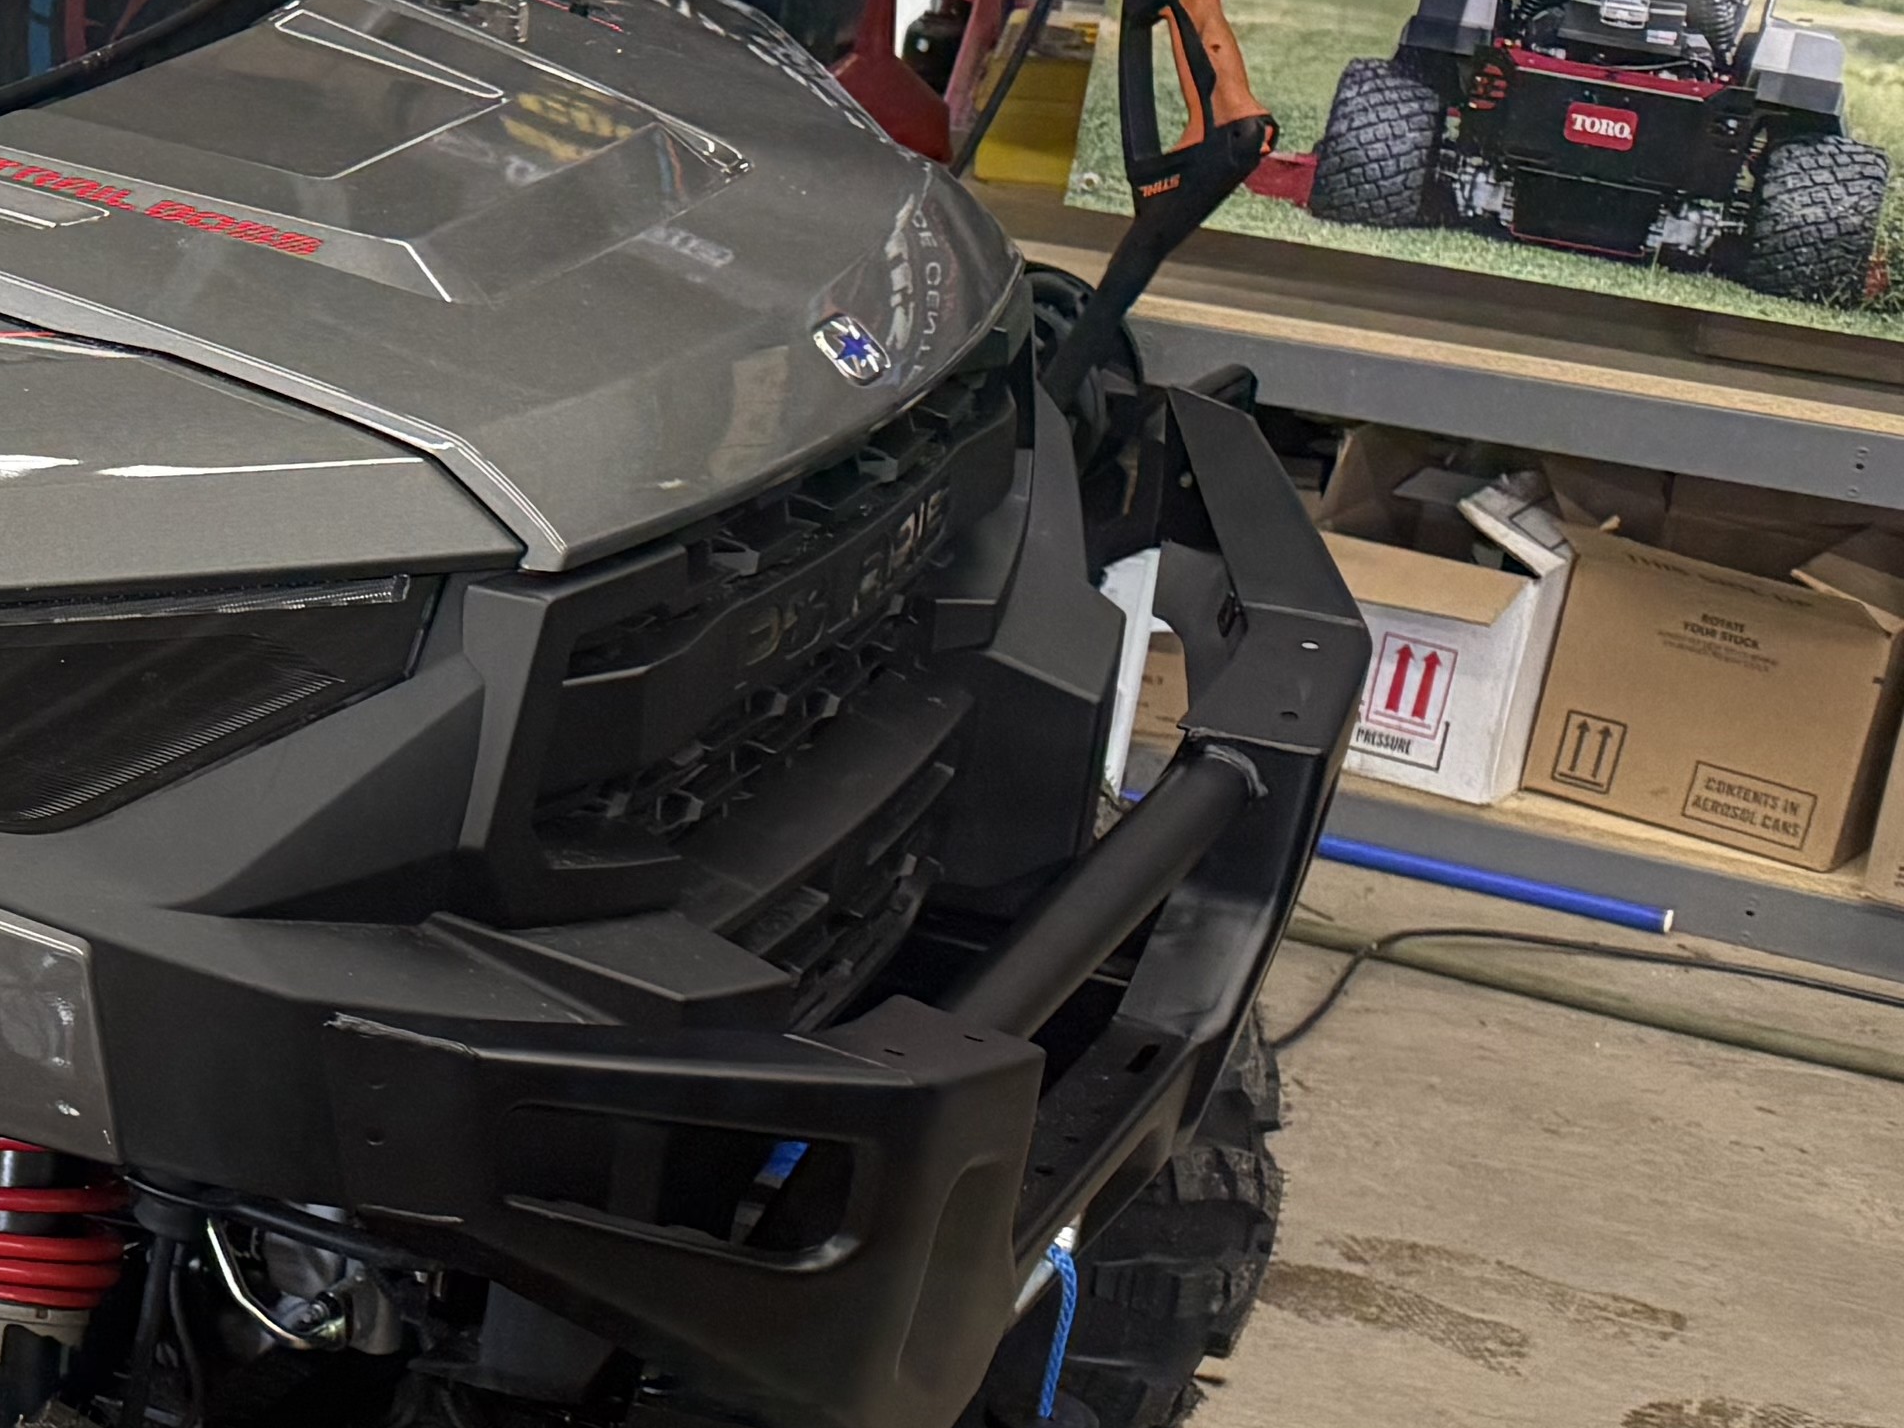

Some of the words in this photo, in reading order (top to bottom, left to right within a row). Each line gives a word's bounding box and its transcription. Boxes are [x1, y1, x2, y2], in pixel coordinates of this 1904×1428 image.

[1570, 112, 1633, 140] TORO
[1691, 794, 1757, 826] AEROSOL
[1759, 814, 1802, 838] CANS
[1704, 776, 1781, 812] CONTENTS
[1782, 798, 1801, 817] IN
